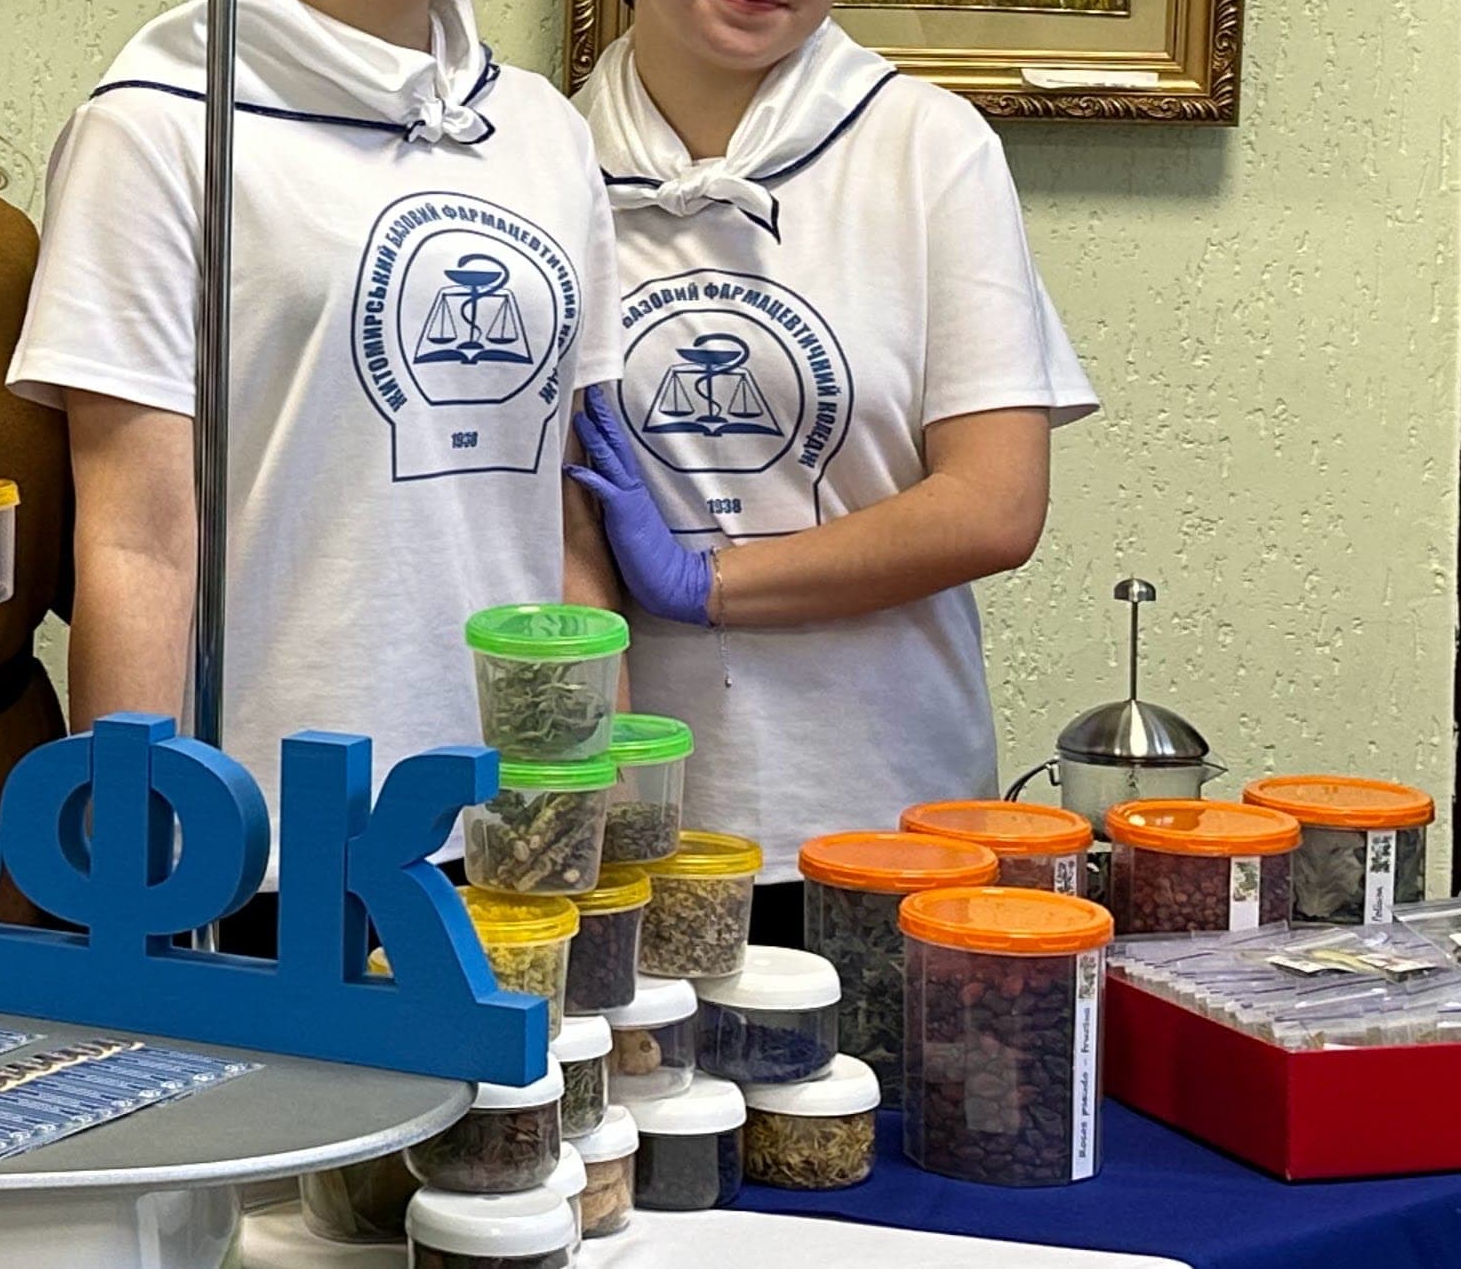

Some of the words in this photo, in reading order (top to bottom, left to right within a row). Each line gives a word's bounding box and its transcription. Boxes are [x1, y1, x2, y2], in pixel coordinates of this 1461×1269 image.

[363, 244, 407, 413] ЖИТОМИРСЬКИЙ
[386, 202, 440, 250] БАЗОВИЙ
[703, 282, 841, 397] ФАРМАЦЕВТИЧНИЙ
[798, 402, 837, 469] КОЛЕДЖ
[706, 498, 742, 515] 1938
